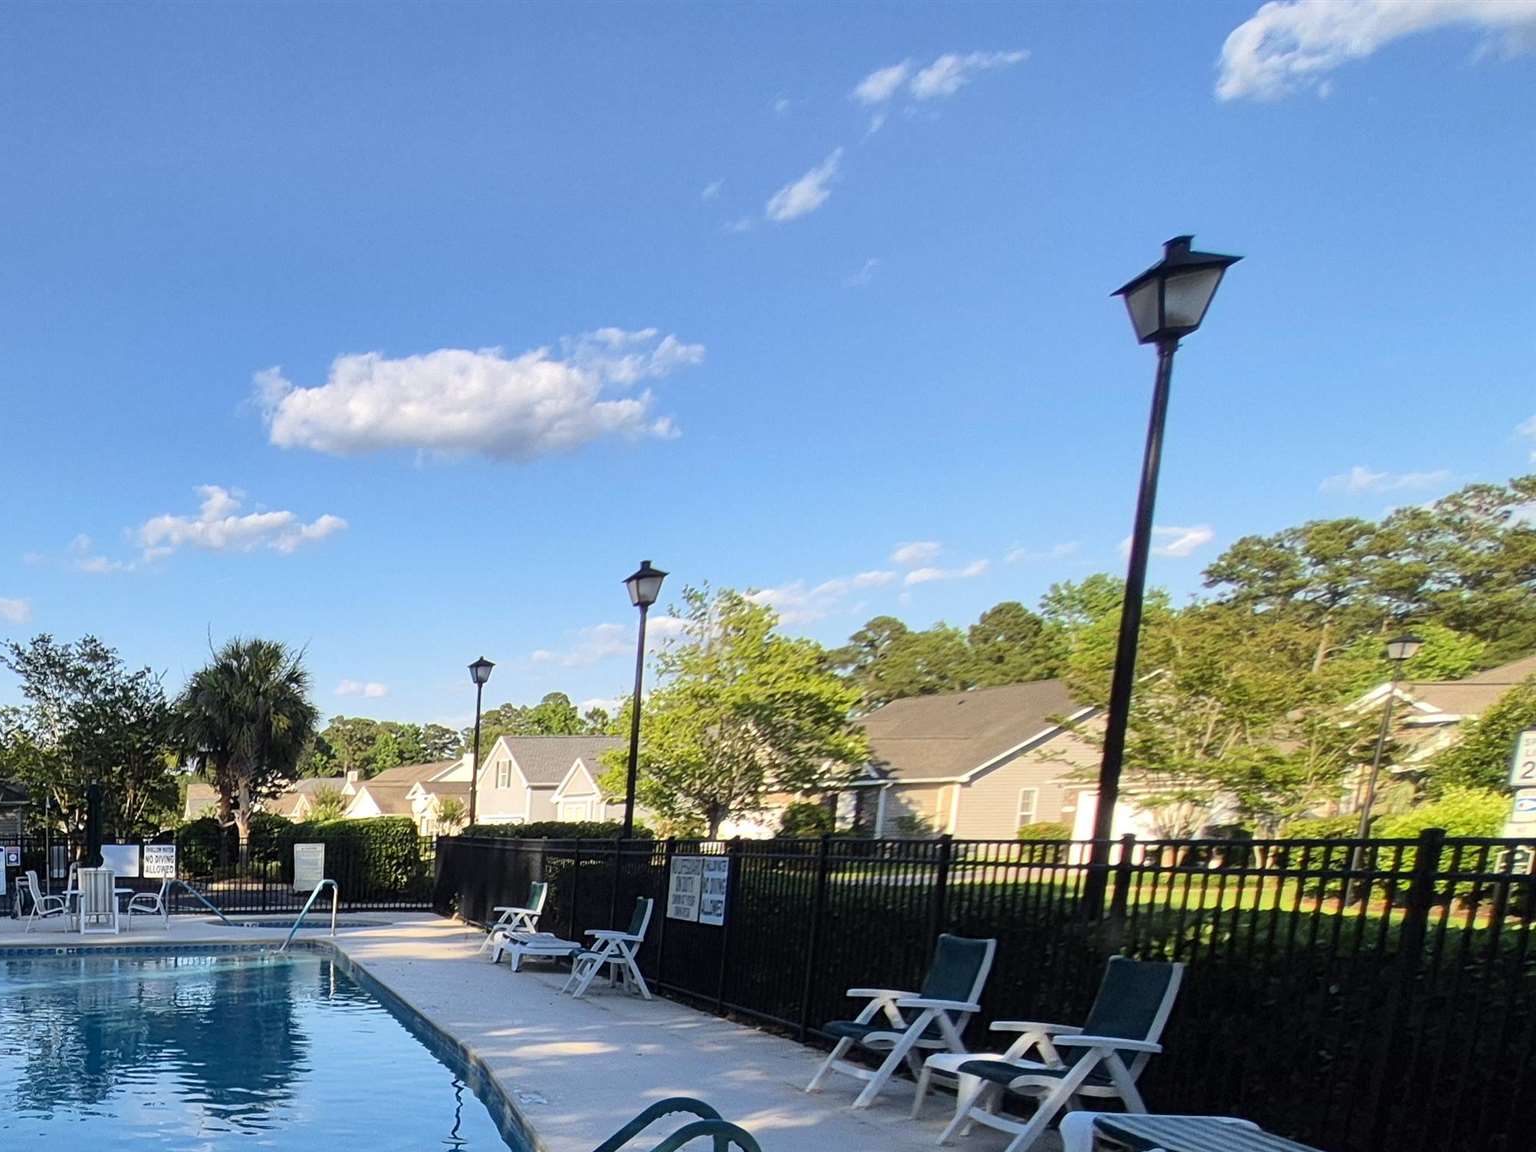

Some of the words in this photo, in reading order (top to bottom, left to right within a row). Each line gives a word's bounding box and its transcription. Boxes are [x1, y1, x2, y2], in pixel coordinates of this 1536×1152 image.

[145, 855, 154, 863] NO
[155, 855, 174, 863] DIVING
[145, 865, 174, 873] ALLOWED
